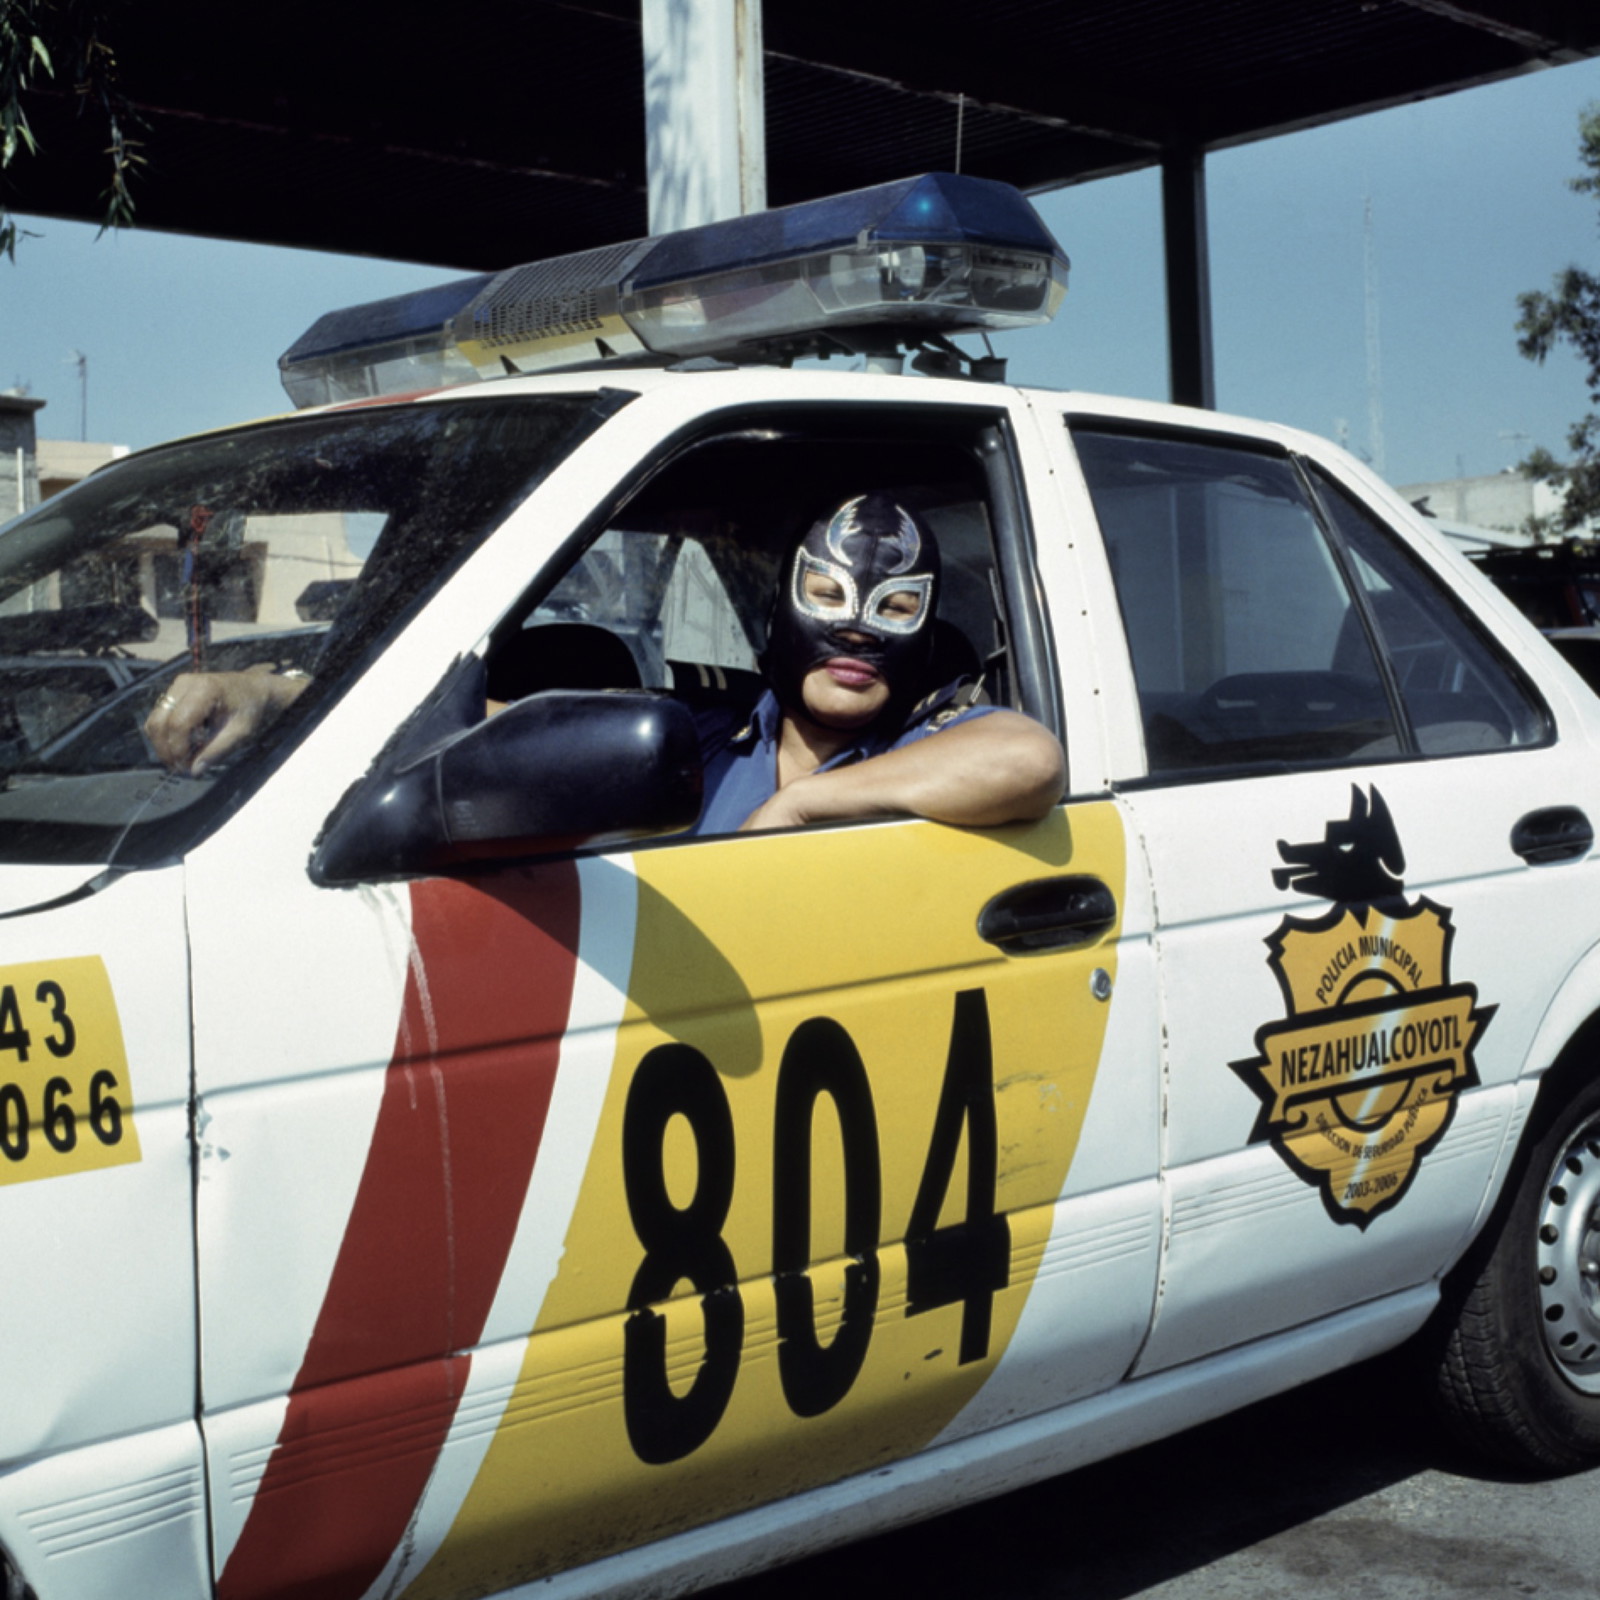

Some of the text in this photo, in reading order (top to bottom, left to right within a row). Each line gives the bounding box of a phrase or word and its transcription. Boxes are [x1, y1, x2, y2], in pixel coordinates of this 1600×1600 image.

[1315, 935, 1423, 1005] POLICIA MUNICIPAL
[0, 979, 76, 1063] 43
[1280, 1014, 1463, 1088] NEZAHUALCOYOTL
[0, 1069, 123, 1161] 066
[622, 987, 1011, 1465] 804
